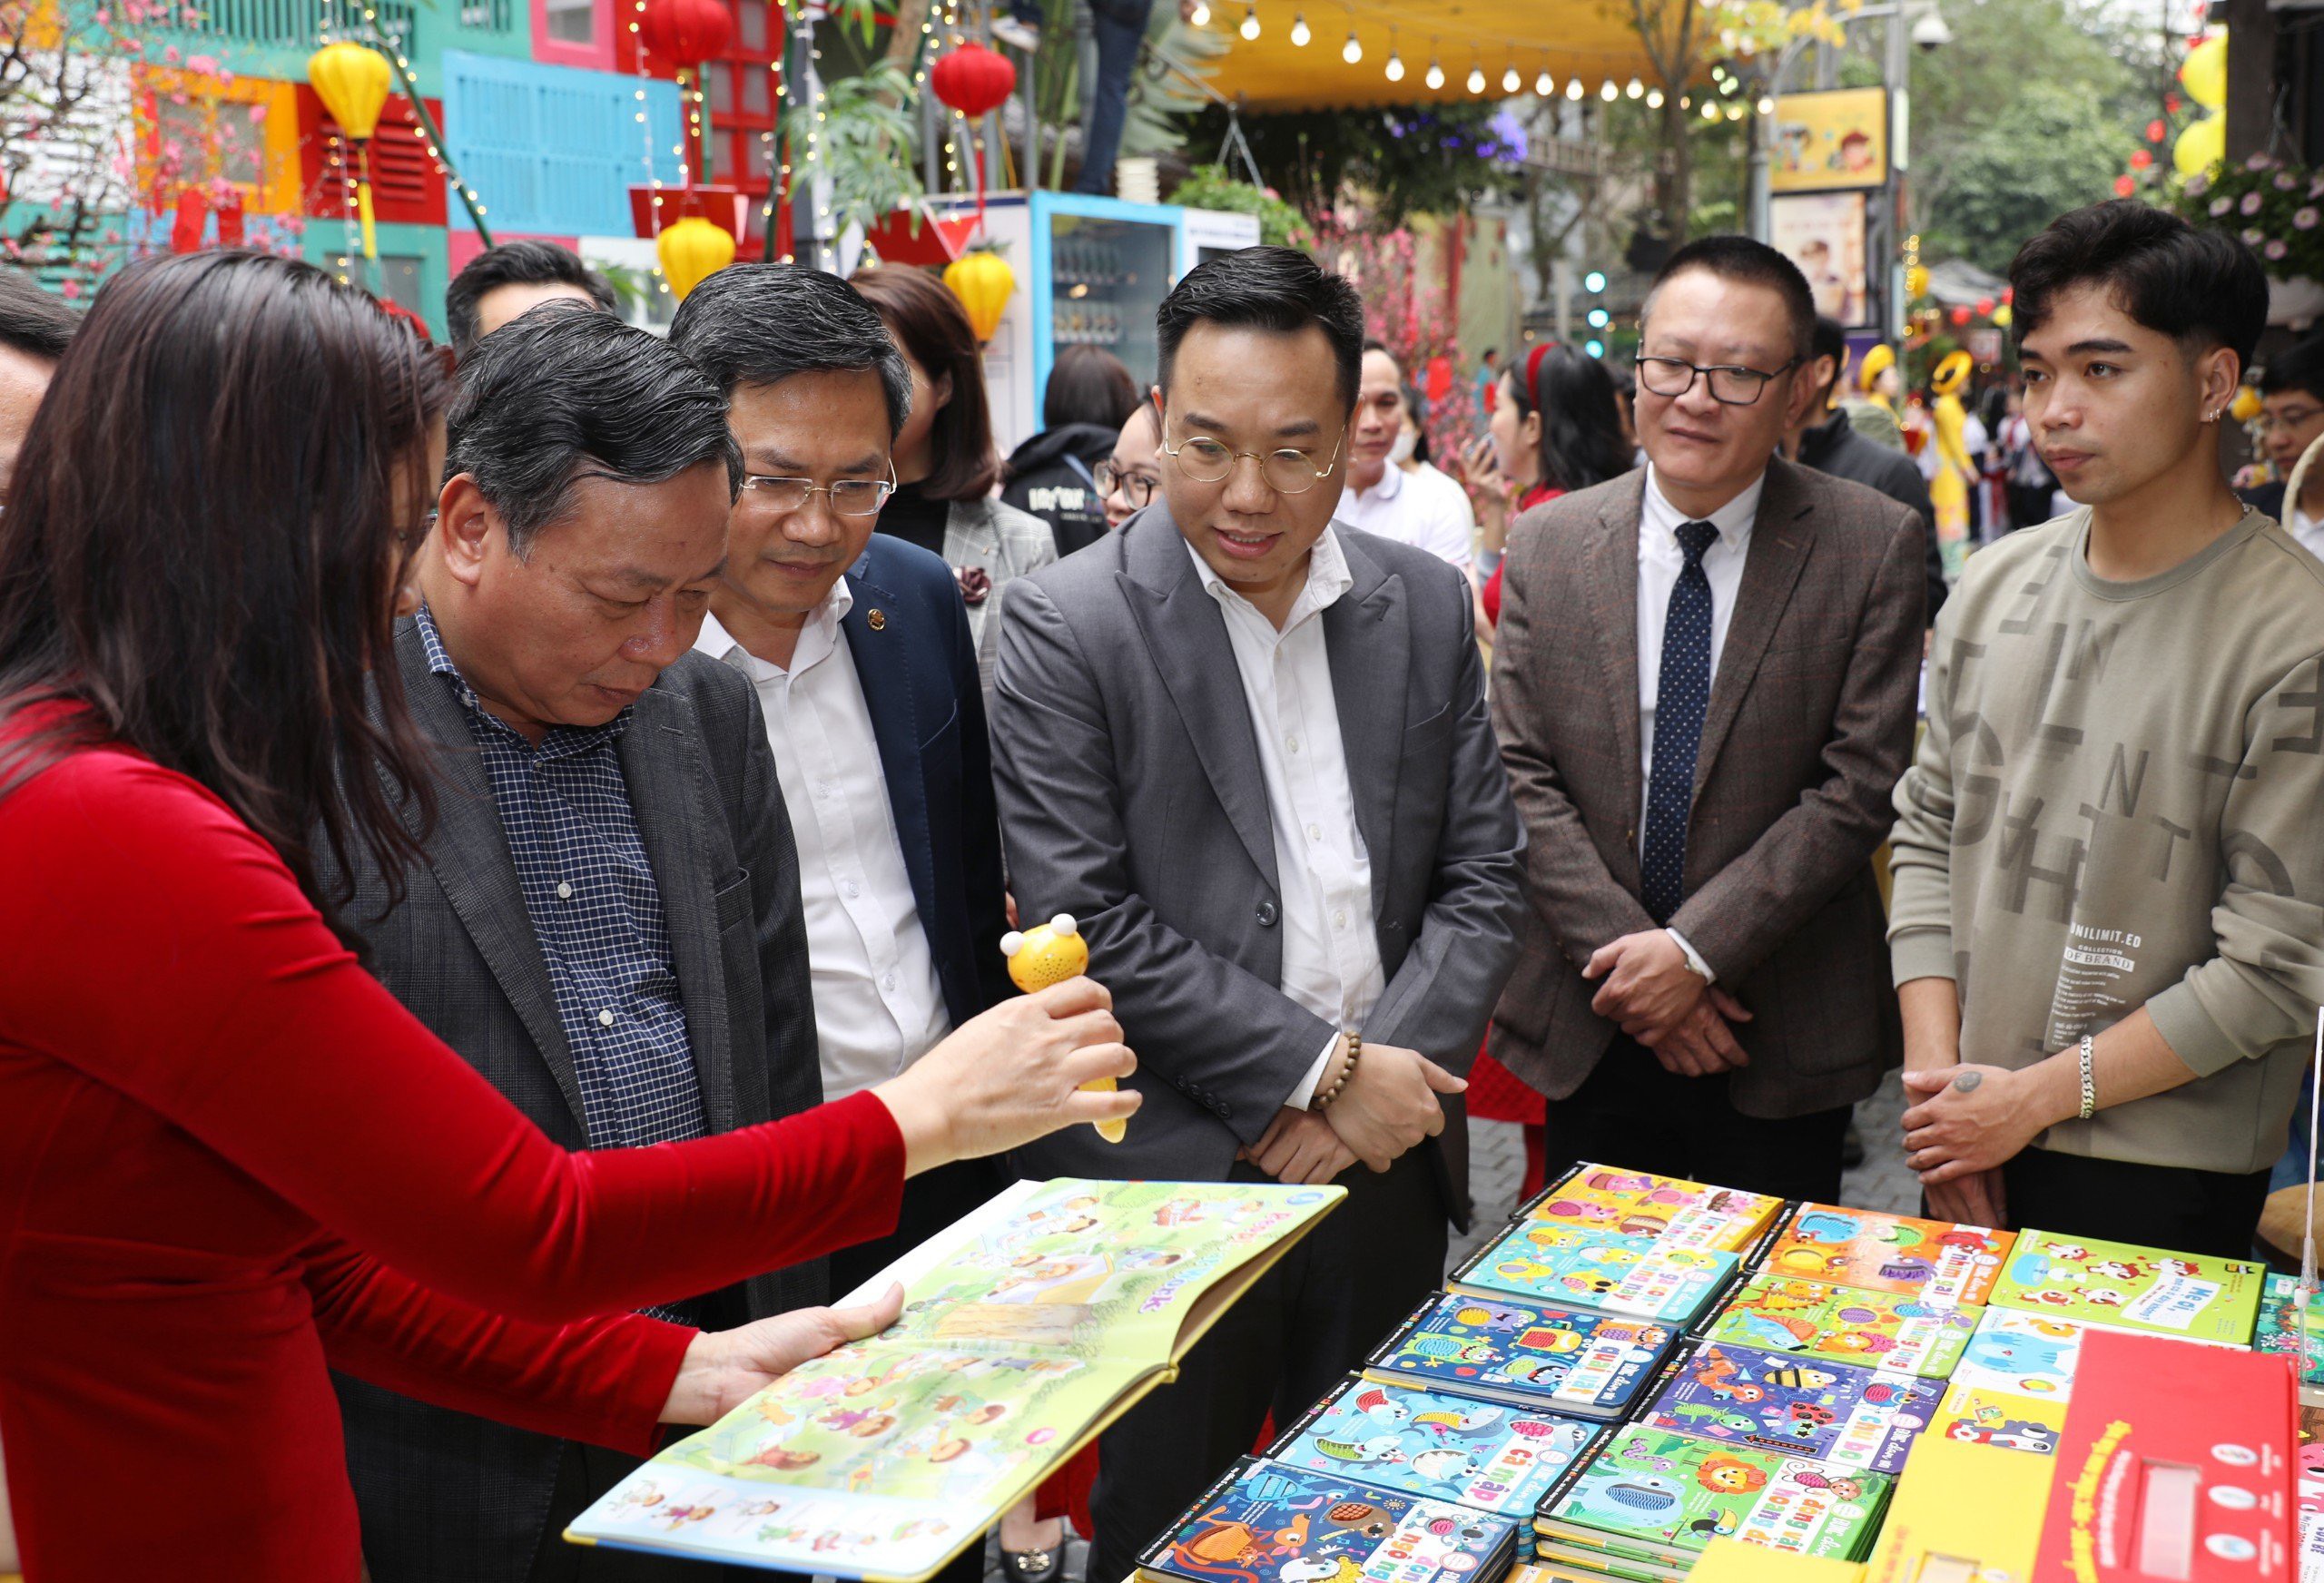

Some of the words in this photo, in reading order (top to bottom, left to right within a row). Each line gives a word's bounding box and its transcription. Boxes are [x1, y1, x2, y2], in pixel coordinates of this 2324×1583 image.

[2065, 949, 2082, 962] OF
[2084, 954, 2131, 969] BRAND
[1645, 1286, 1668, 1301] con
[1934, 1280, 1955, 1295] gai
[1888, 1347, 1919, 1368] long
[1503, 1449, 1539, 1465] cá
[1834, 1441, 1872, 1460] bọ
[1471, 1468, 1514, 1500] mập
[1751, 1489, 1797, 1528] hoang
[1384, 1532, 1423, 1559] ngộ
[1401, 1555, 1438, 1583] độn
